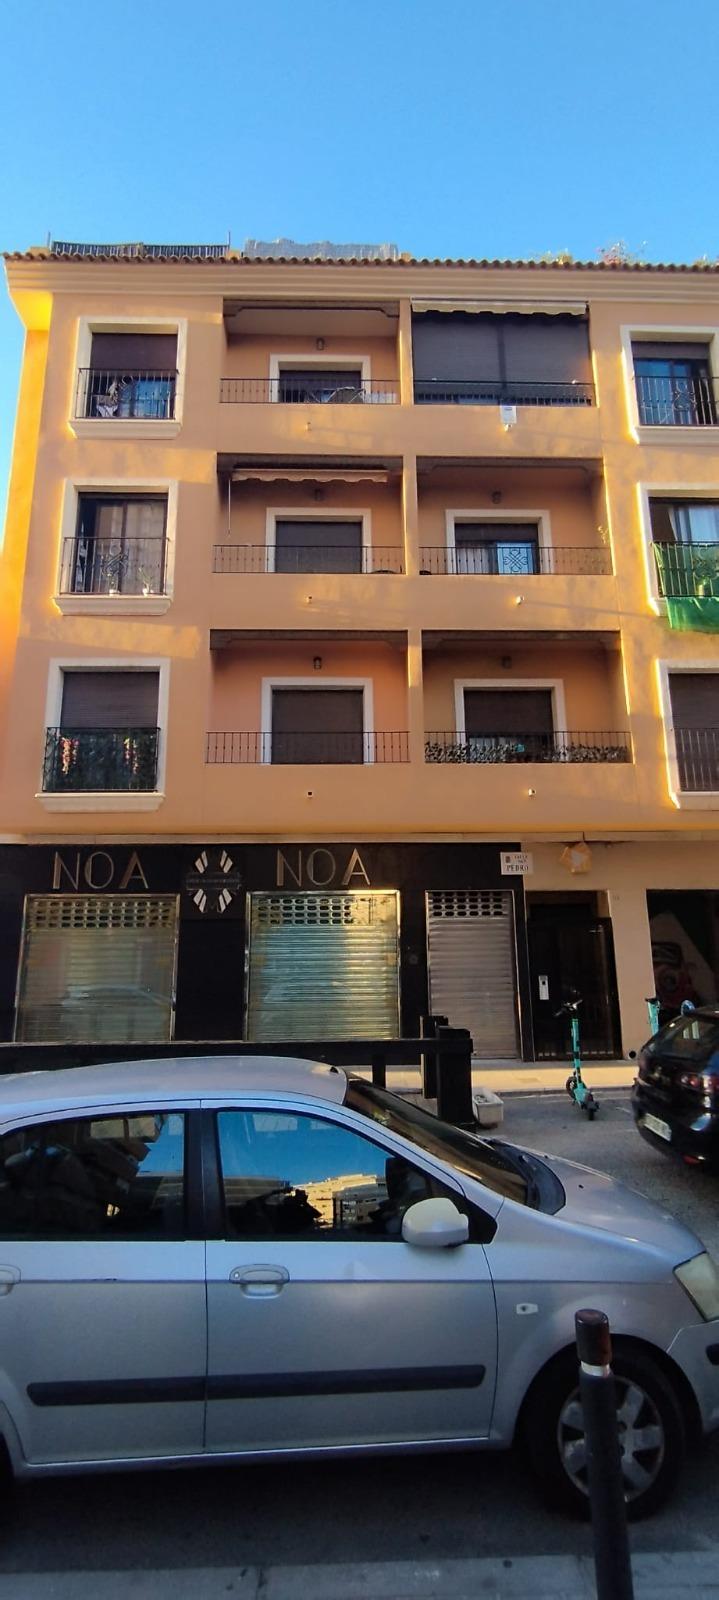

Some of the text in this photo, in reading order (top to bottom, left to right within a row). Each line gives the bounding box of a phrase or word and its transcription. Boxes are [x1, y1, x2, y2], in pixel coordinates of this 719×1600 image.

[52, 851, 149, 890] NOA
[277, 848, 370, 886] NOA
[506, 864, 529, 872] PEDRO
